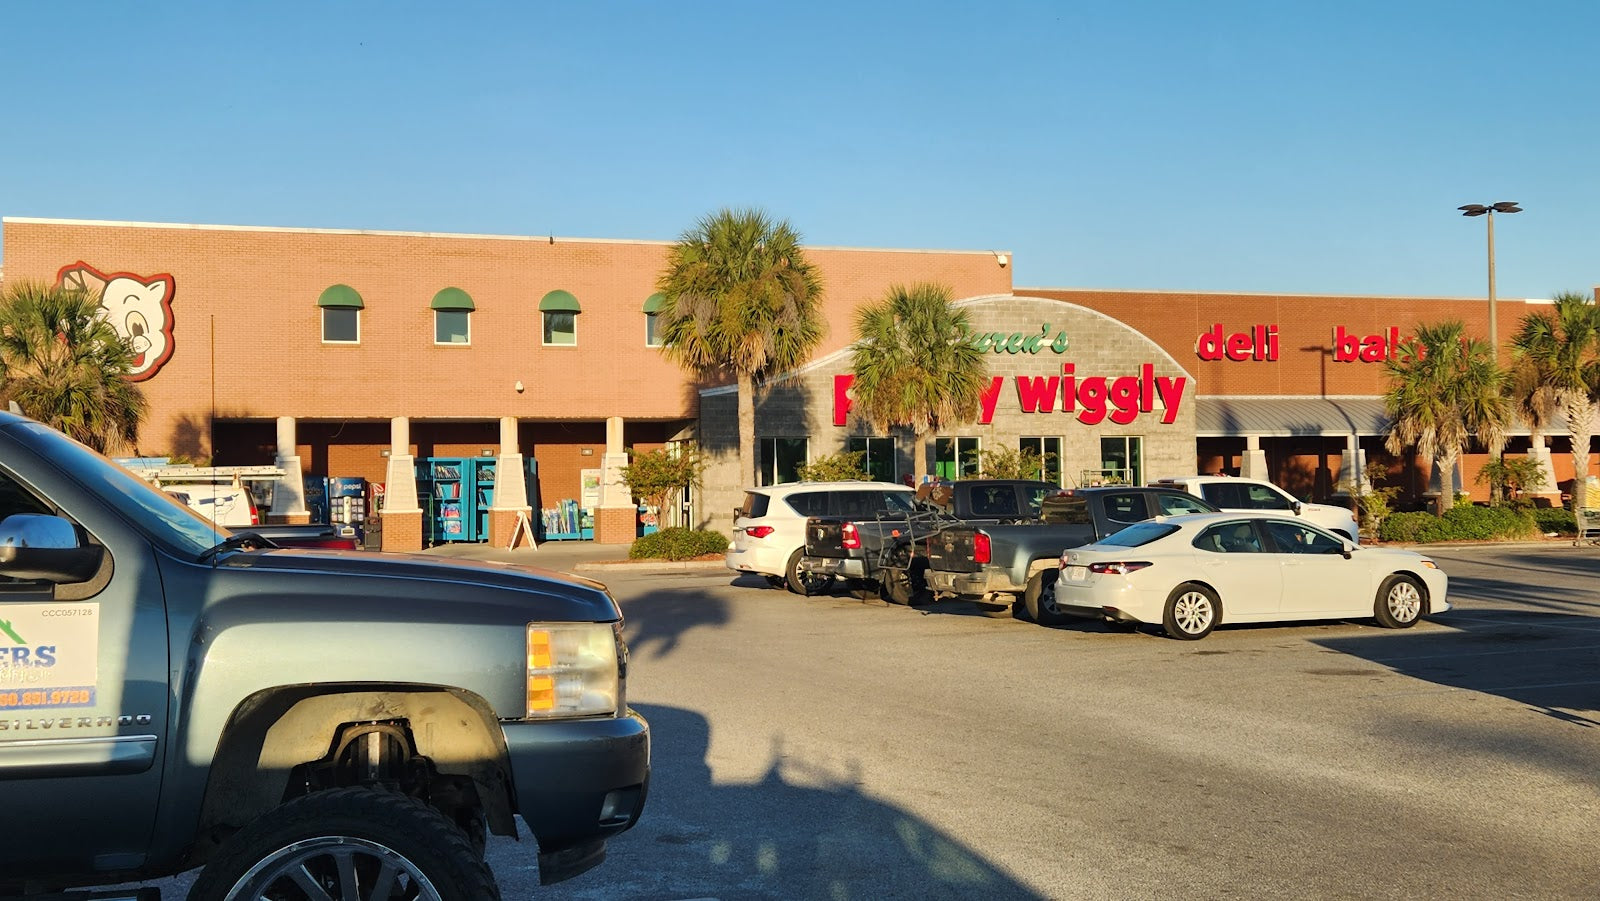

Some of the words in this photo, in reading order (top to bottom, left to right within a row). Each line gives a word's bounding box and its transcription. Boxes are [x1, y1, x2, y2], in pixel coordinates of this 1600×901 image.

[953, 322, 1069, 354] uren's
[1197, 323, 1279, 361] deli
[1017, 363, 1187, 425] wiggly
[343, 483, 362, 491] pepsi
[41, 609, 93, 617] CCC057128
[0, 714, 151, 731] SILVERADO
